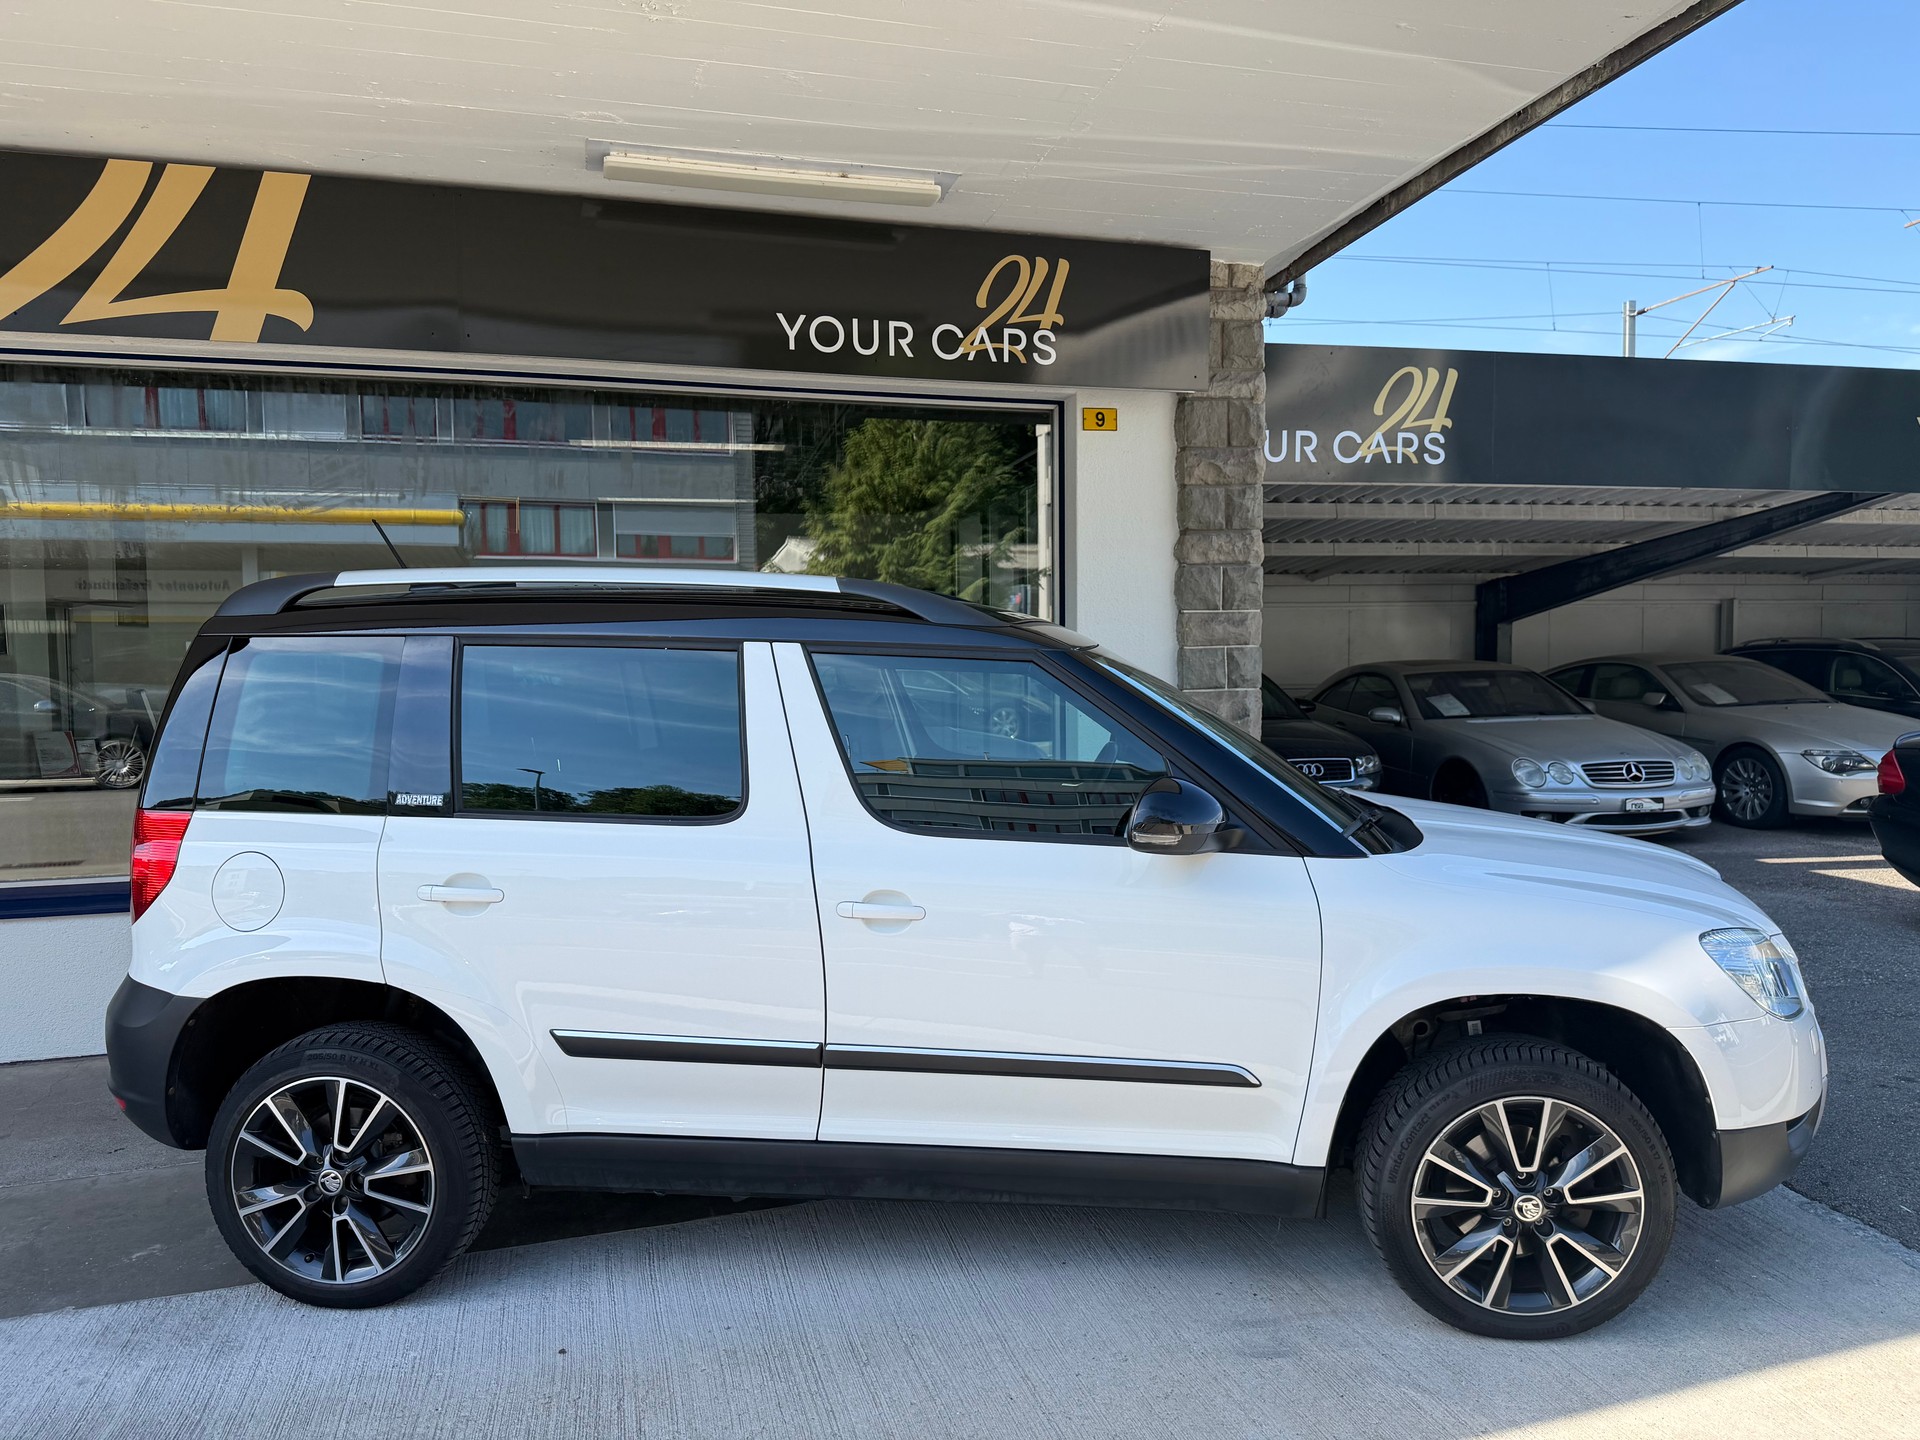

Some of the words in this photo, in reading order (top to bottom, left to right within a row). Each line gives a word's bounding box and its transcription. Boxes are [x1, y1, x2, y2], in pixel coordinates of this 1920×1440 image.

[962, 254, 1070, 364] 24
[776, 312, 914, 357] YOUR
[931, 323, 1057, 366] CARS
[1096, 411, 1105, 427] 9
[1359, 366, 1459, 464] 24
[1264, 430, 1318, 463] UR
[1333, 430, 1446, 465] CARS
[395, 794, 443, 806] ADVENTURE
[1387, 1112, 1432, 1184] WinterContact
[1627, 1114, 1652, 1144] 205/50
